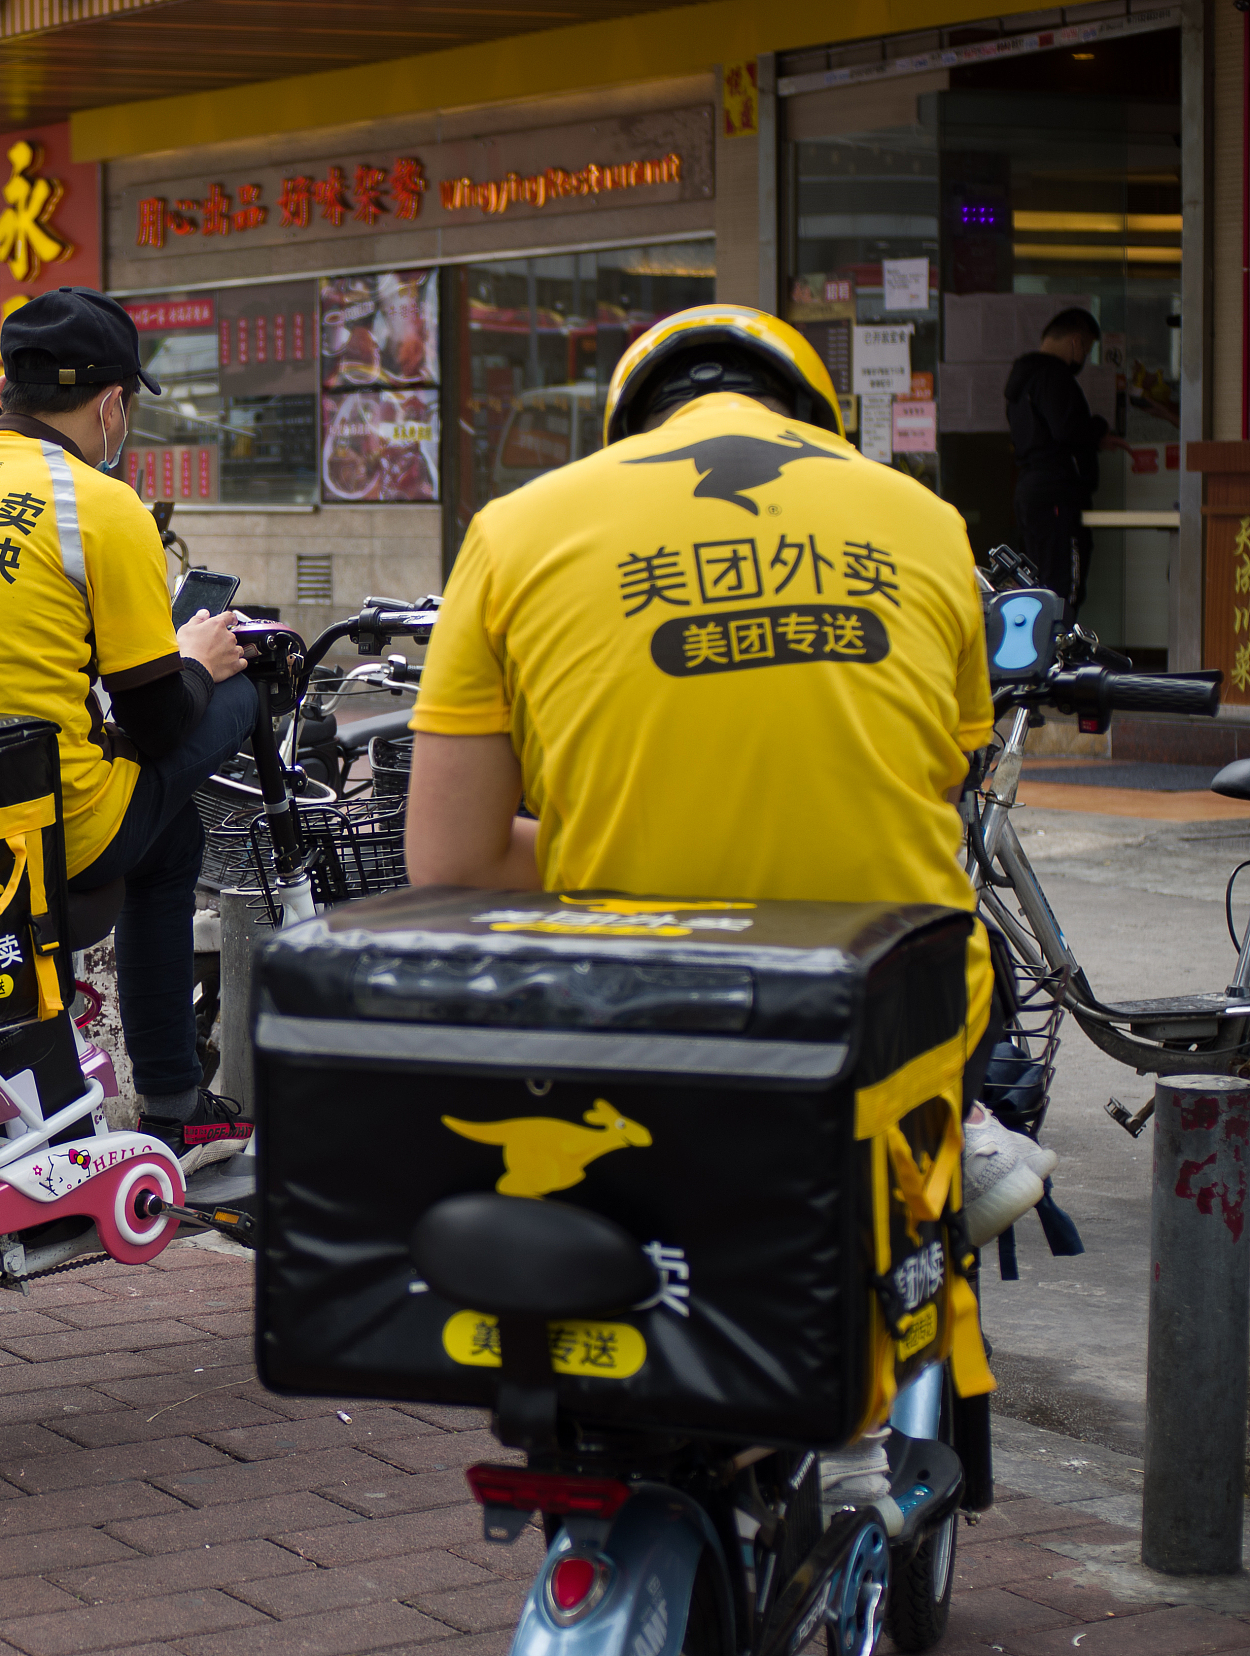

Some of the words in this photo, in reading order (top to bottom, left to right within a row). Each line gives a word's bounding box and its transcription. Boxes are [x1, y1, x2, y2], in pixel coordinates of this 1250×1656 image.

[617, 534, 902, 618] 美团外卖
[682, 613, 868, 668] 美团专送
